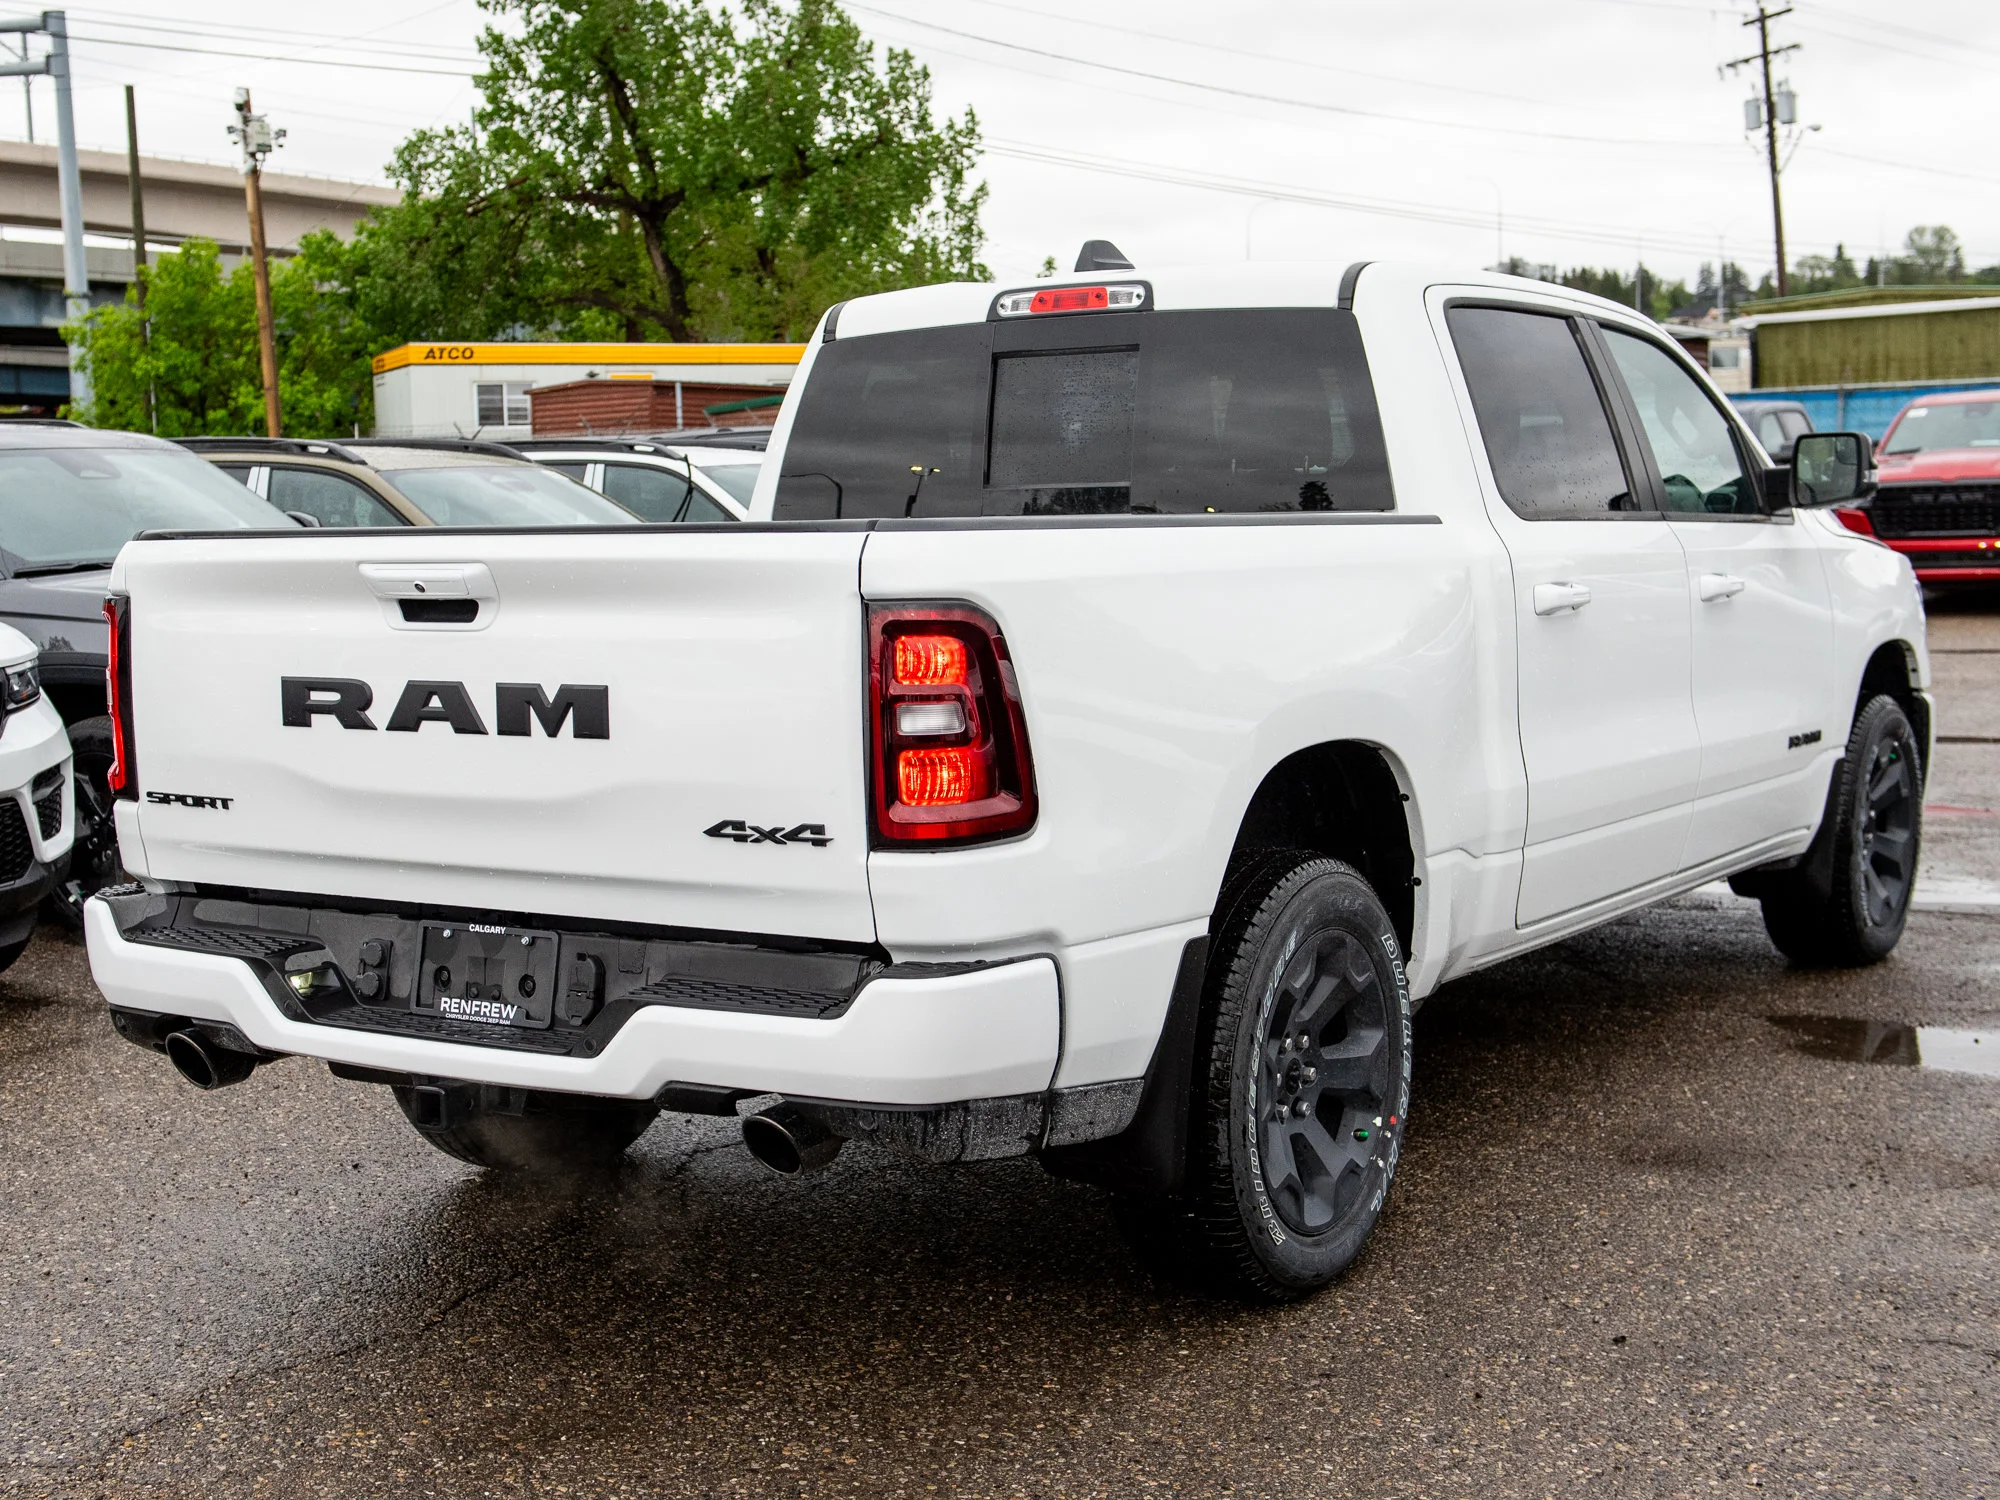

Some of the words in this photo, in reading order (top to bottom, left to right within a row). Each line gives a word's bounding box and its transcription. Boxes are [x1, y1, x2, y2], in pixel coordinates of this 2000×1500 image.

[424, 347, 474, 360] ATCO
[281, 676, 609, 738] RAM
[146, 791, 234, 810] SPORT
[703, 819, 834, 847] 4x4
[469, 923, 506, 935] CALGARY
[440, 997, 516, 1019] RENFREW
[445, 1013, 470, 1021] CHRYSLER
[1381, 933, 1412, 1120] DUELER
[1249, 930, 1297, 1246] BRIDGESTONE
